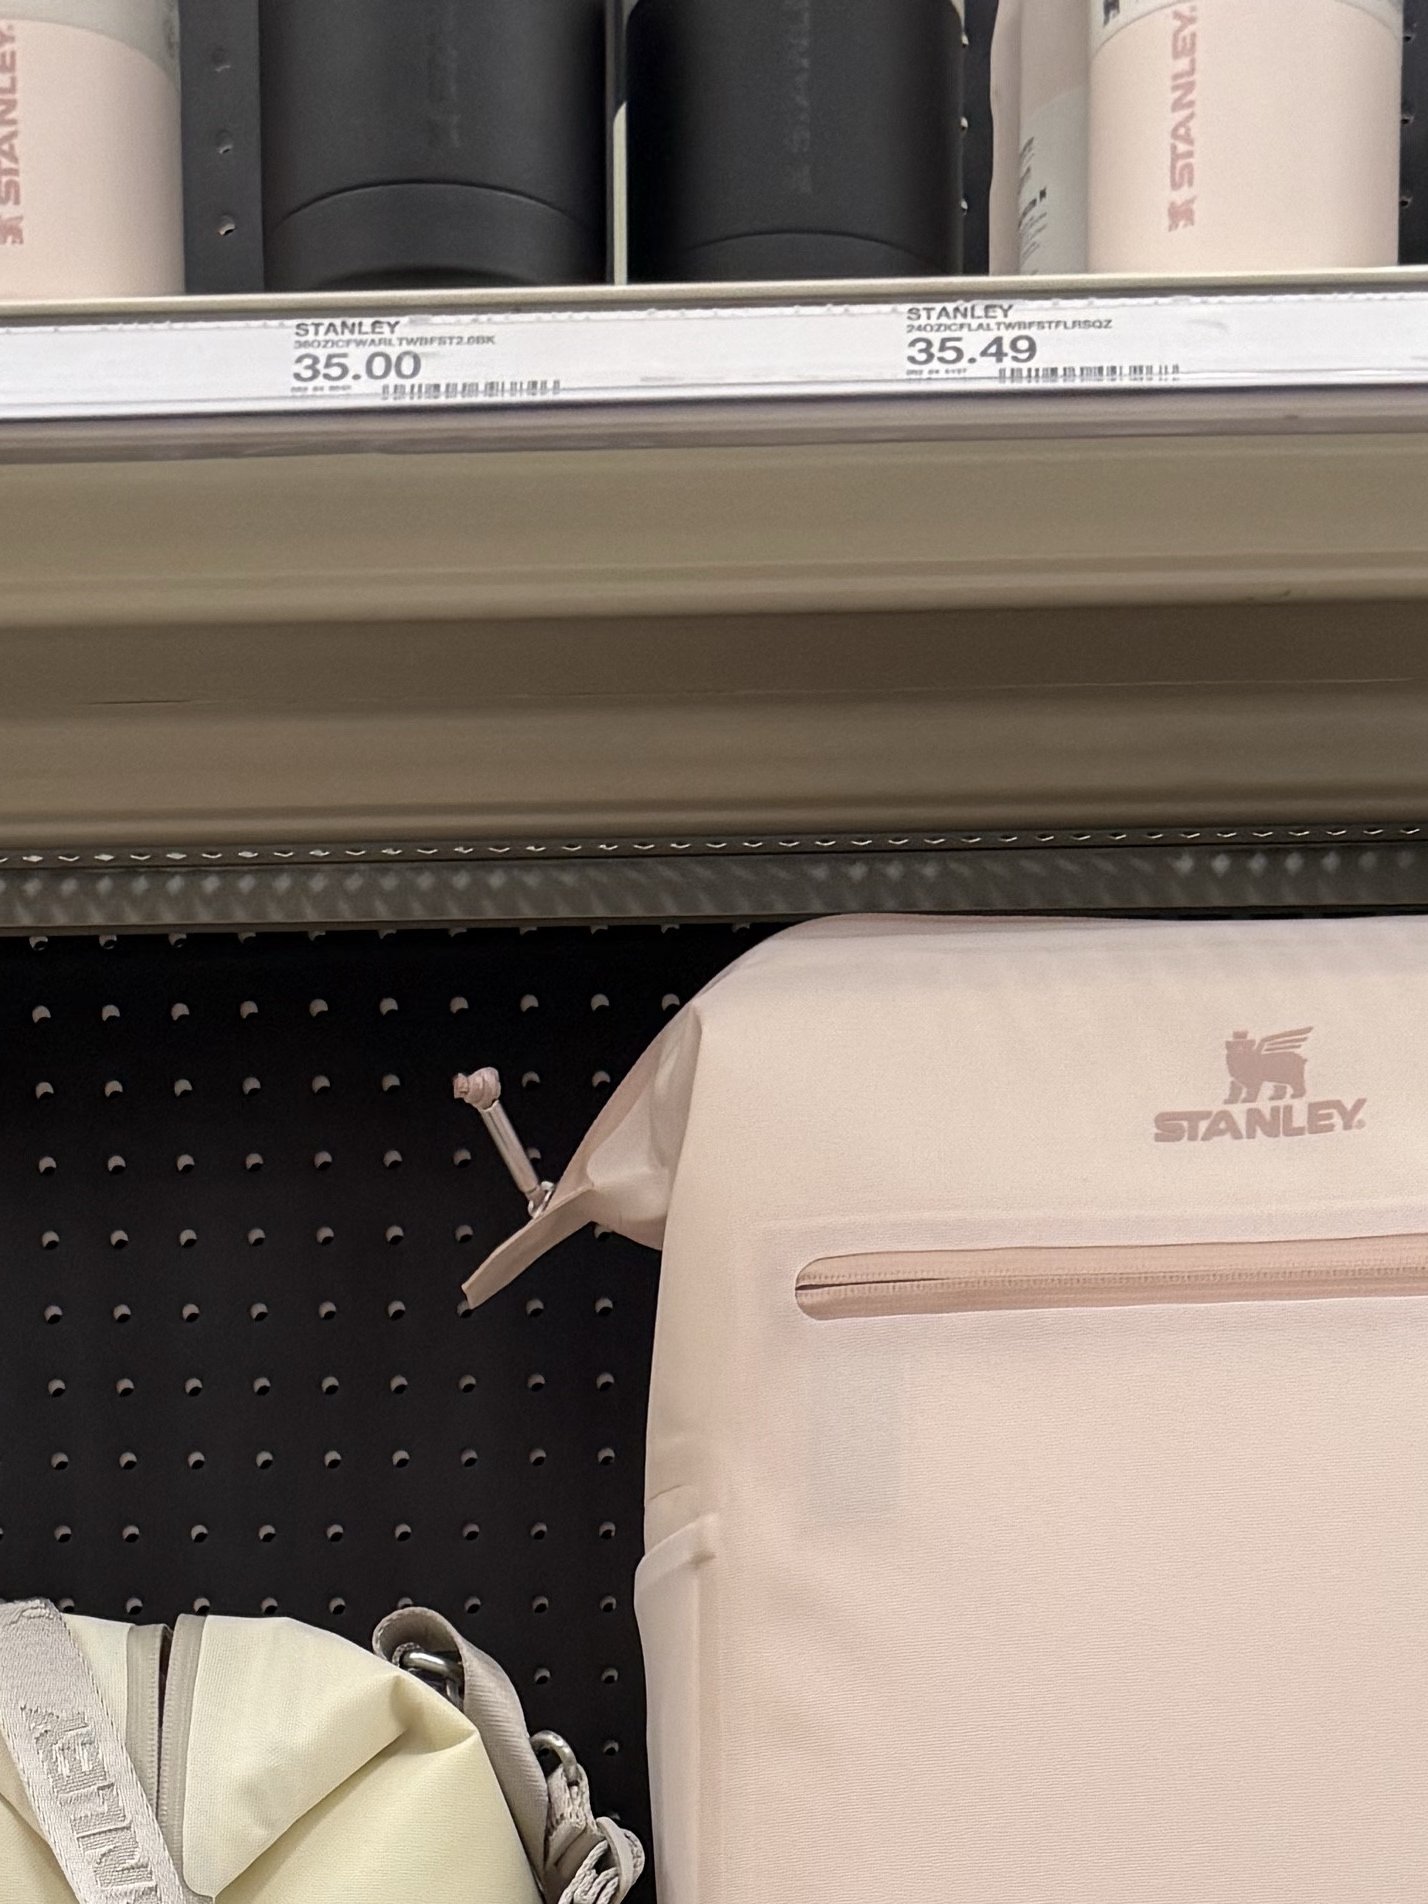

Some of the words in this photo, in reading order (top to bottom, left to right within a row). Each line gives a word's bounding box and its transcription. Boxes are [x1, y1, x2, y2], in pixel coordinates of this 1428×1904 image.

[1168, 2, 1199, 196] STANLEY
[906, 304, 1014, 321] STANLEY
[295, 320, 401, 337] STANLEY
[906, 335, 1037, 365] 35.49
[292, 350, 422, 382] 35.00
[1153, 1098, 1368, 1143] STANLEY
